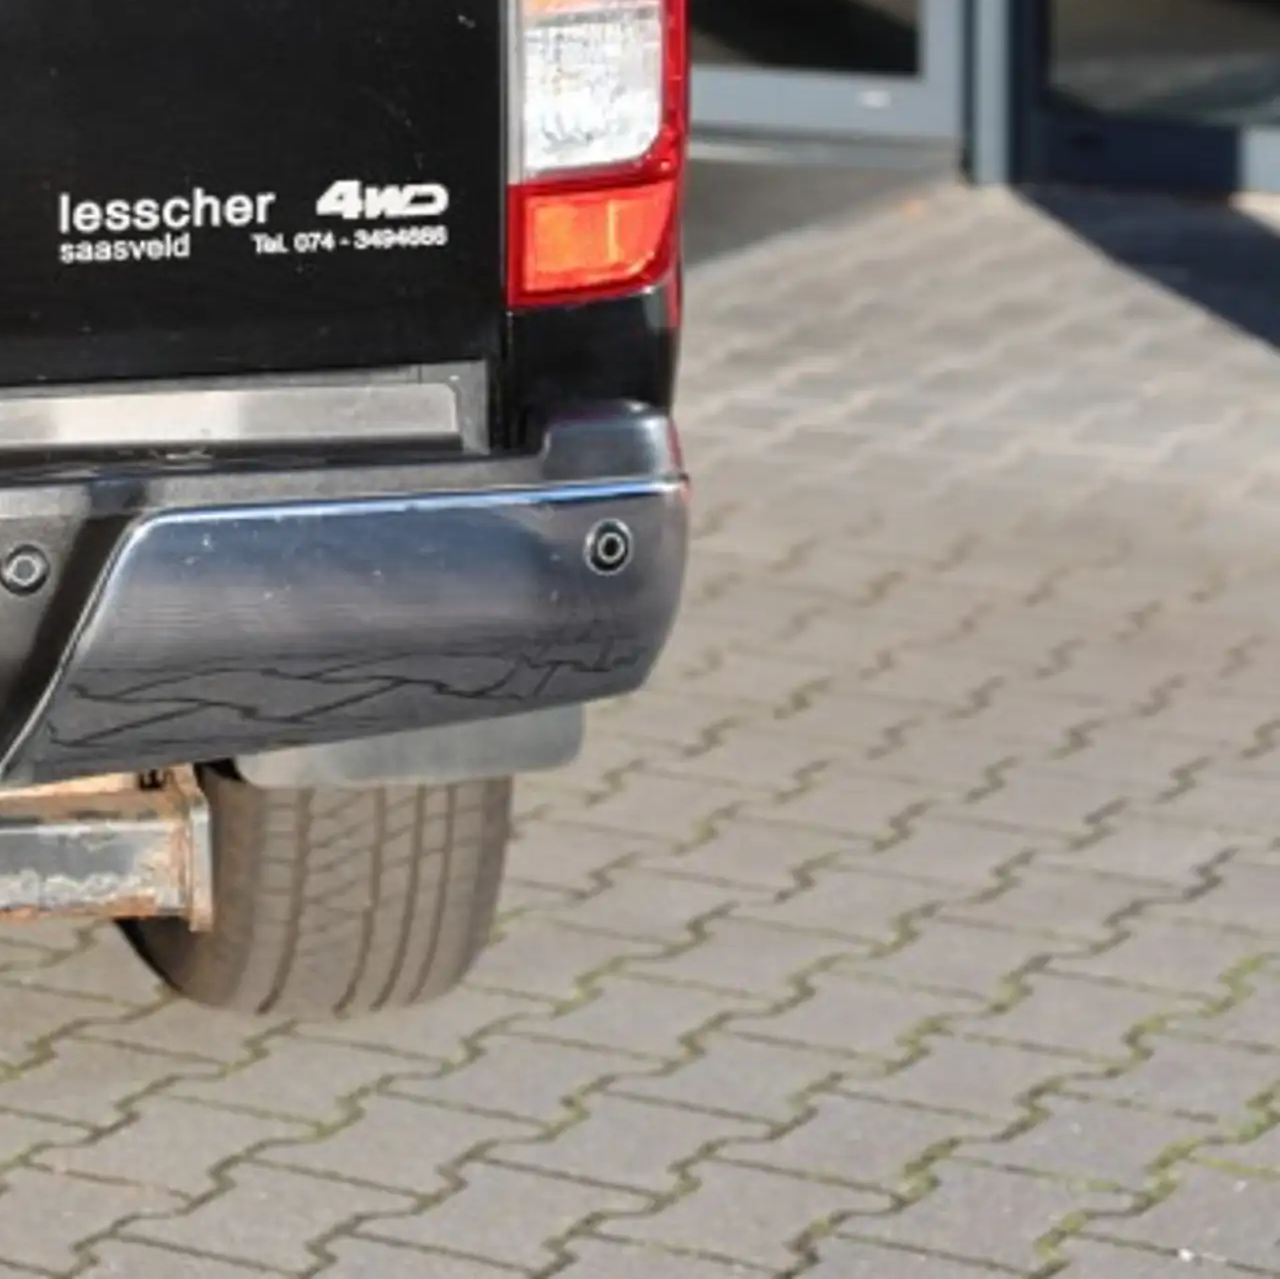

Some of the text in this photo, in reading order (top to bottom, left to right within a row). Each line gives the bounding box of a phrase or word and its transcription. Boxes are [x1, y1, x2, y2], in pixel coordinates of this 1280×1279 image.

[59, 187, 277, 234] lesscher
[59, 232, 191, 264] saasveld
[293, 230, 336, 253] 074
